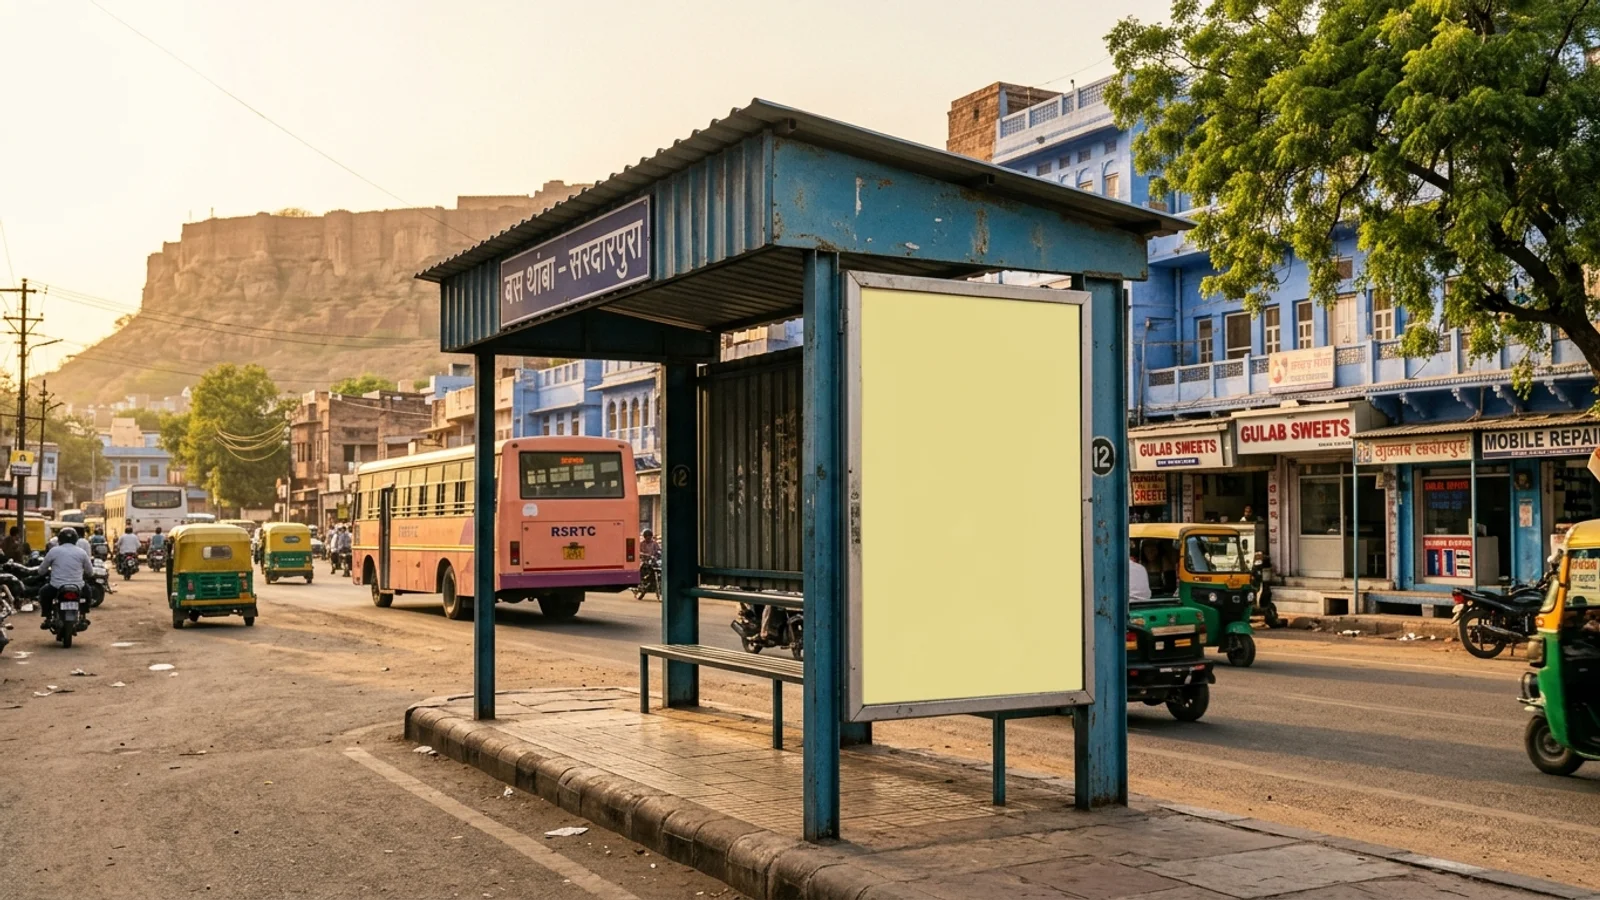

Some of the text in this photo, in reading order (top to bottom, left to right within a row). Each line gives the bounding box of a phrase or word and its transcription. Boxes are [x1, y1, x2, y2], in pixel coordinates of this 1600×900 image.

[504, 269, 523, 304] बस
[526, 252, 556, 297] थांबा
[568, 219, 643, 280] सरदारपुरा
[1241, 418, 1350, 443] GULAB SWEETS
[1484, 427, 1600, 450] MOBILE REPAI
[1094, 445, 1110, 468] 12
[1140, 442, 1173, 457] GULAB
[551, 526, 596, 537] RSRTC
